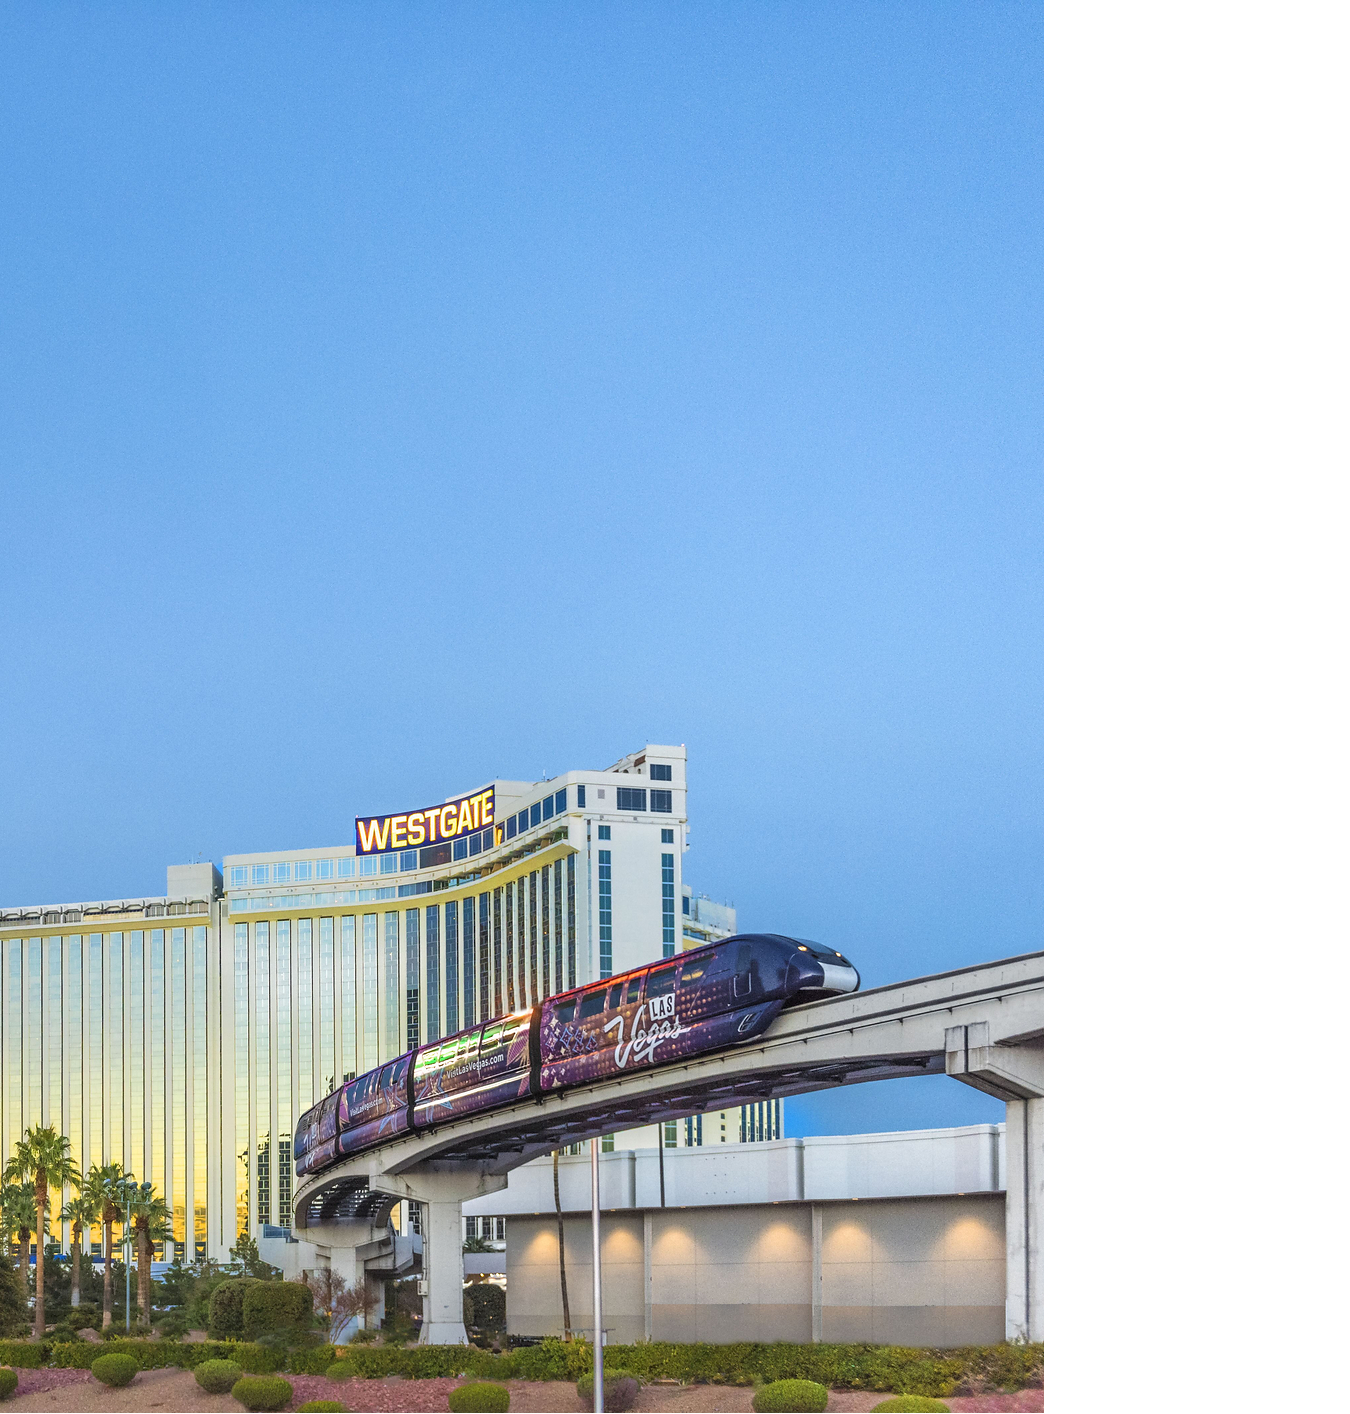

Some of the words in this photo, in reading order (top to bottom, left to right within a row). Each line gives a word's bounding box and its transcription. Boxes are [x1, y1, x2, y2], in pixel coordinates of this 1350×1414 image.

[357, 789, 494, 852] WESTGATE
[651, 995, 674, 1019] LAS
[603, 1004, 691, 1068] Vegas
[446, 1053, 504, 1079] VisitLasVegas.com
